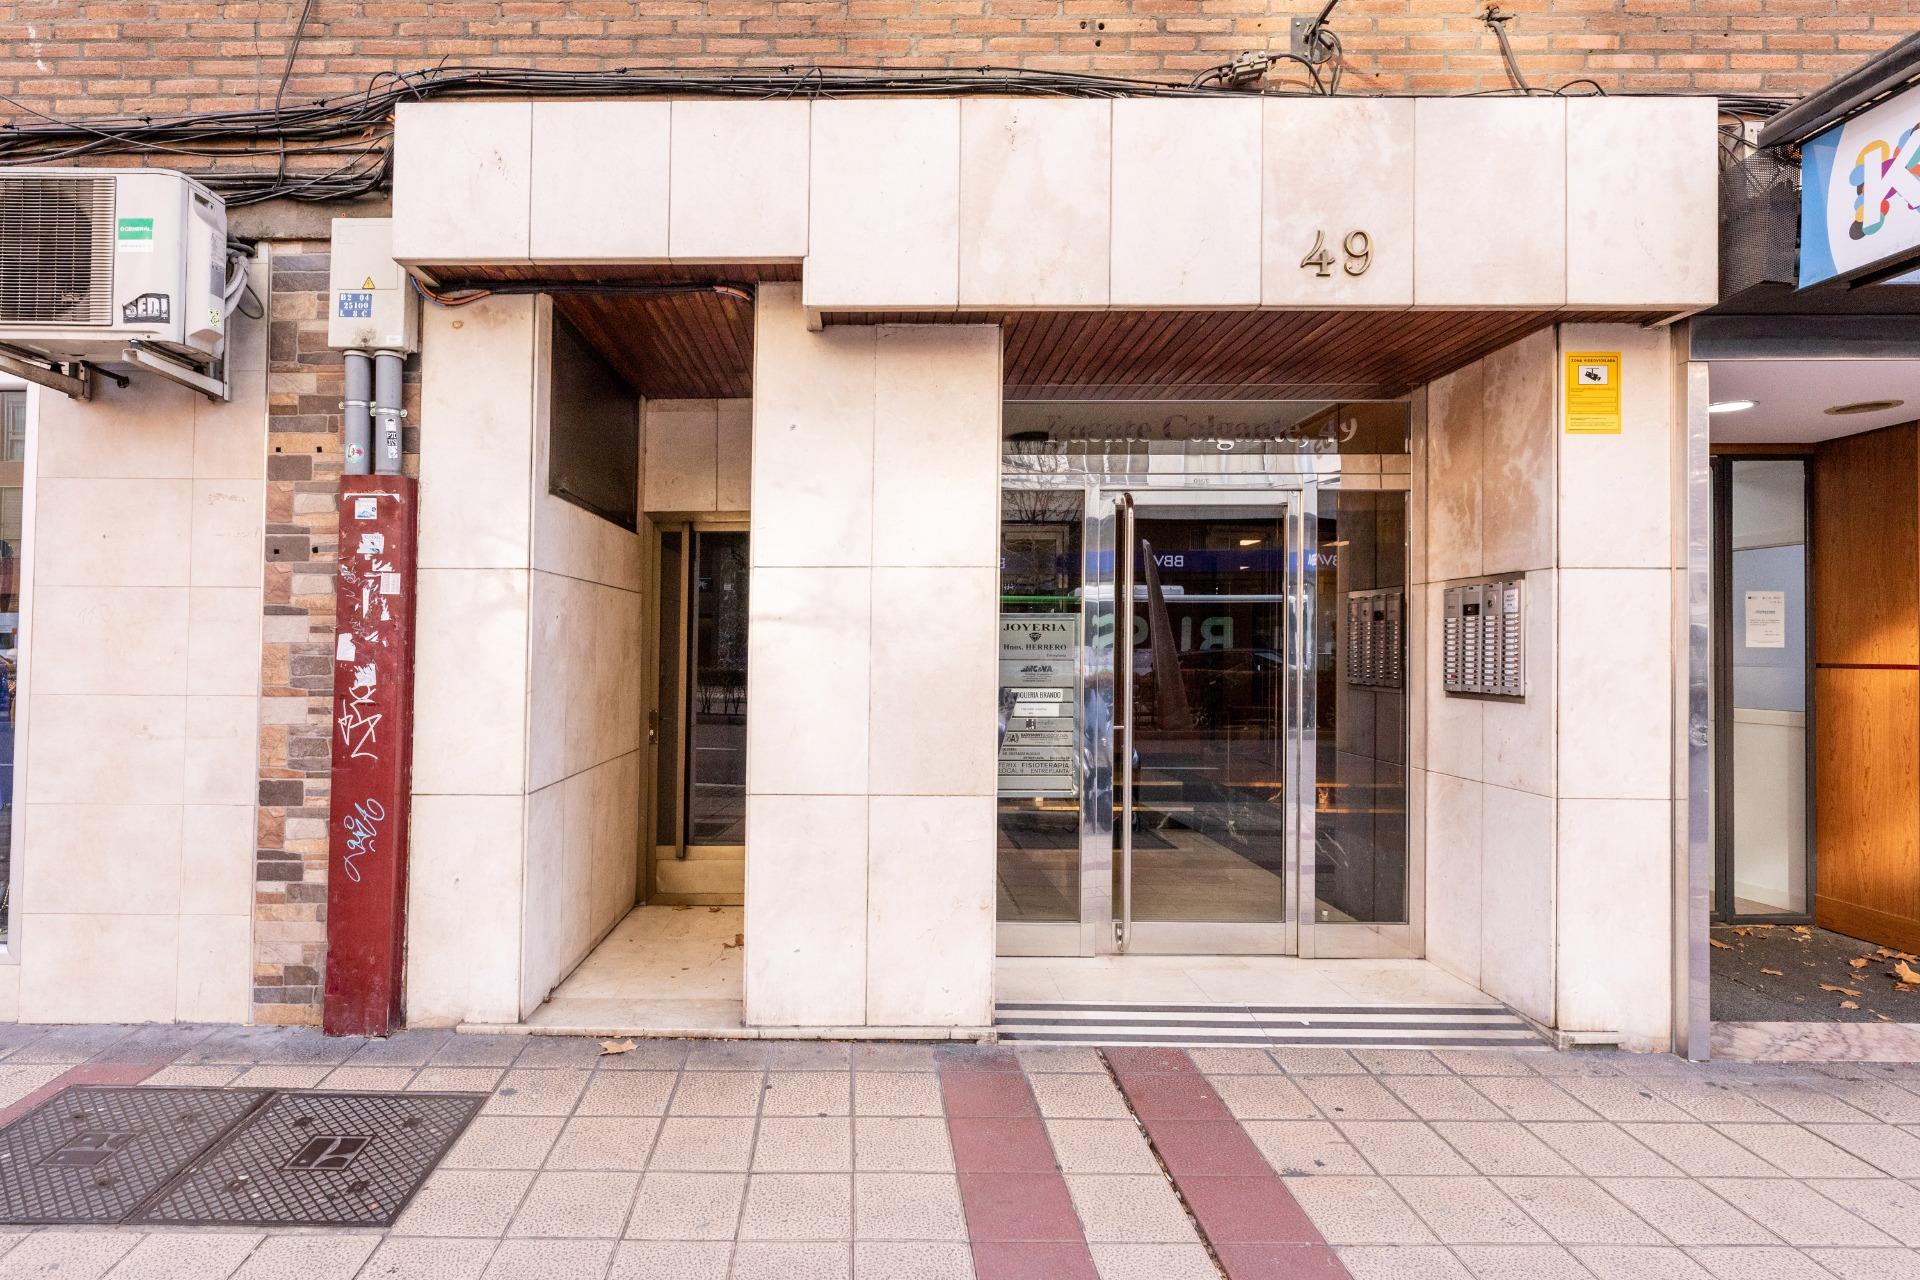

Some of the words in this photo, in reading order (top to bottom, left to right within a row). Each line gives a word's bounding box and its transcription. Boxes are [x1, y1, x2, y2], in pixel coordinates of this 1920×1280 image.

[1300, 230, 1374, 277] 49
[1003, 623, 1067, 632] JOYERIA
[1026, 643, 1067, 651] HERRERO
[1018, 691, 1039, 699] QUERIA
